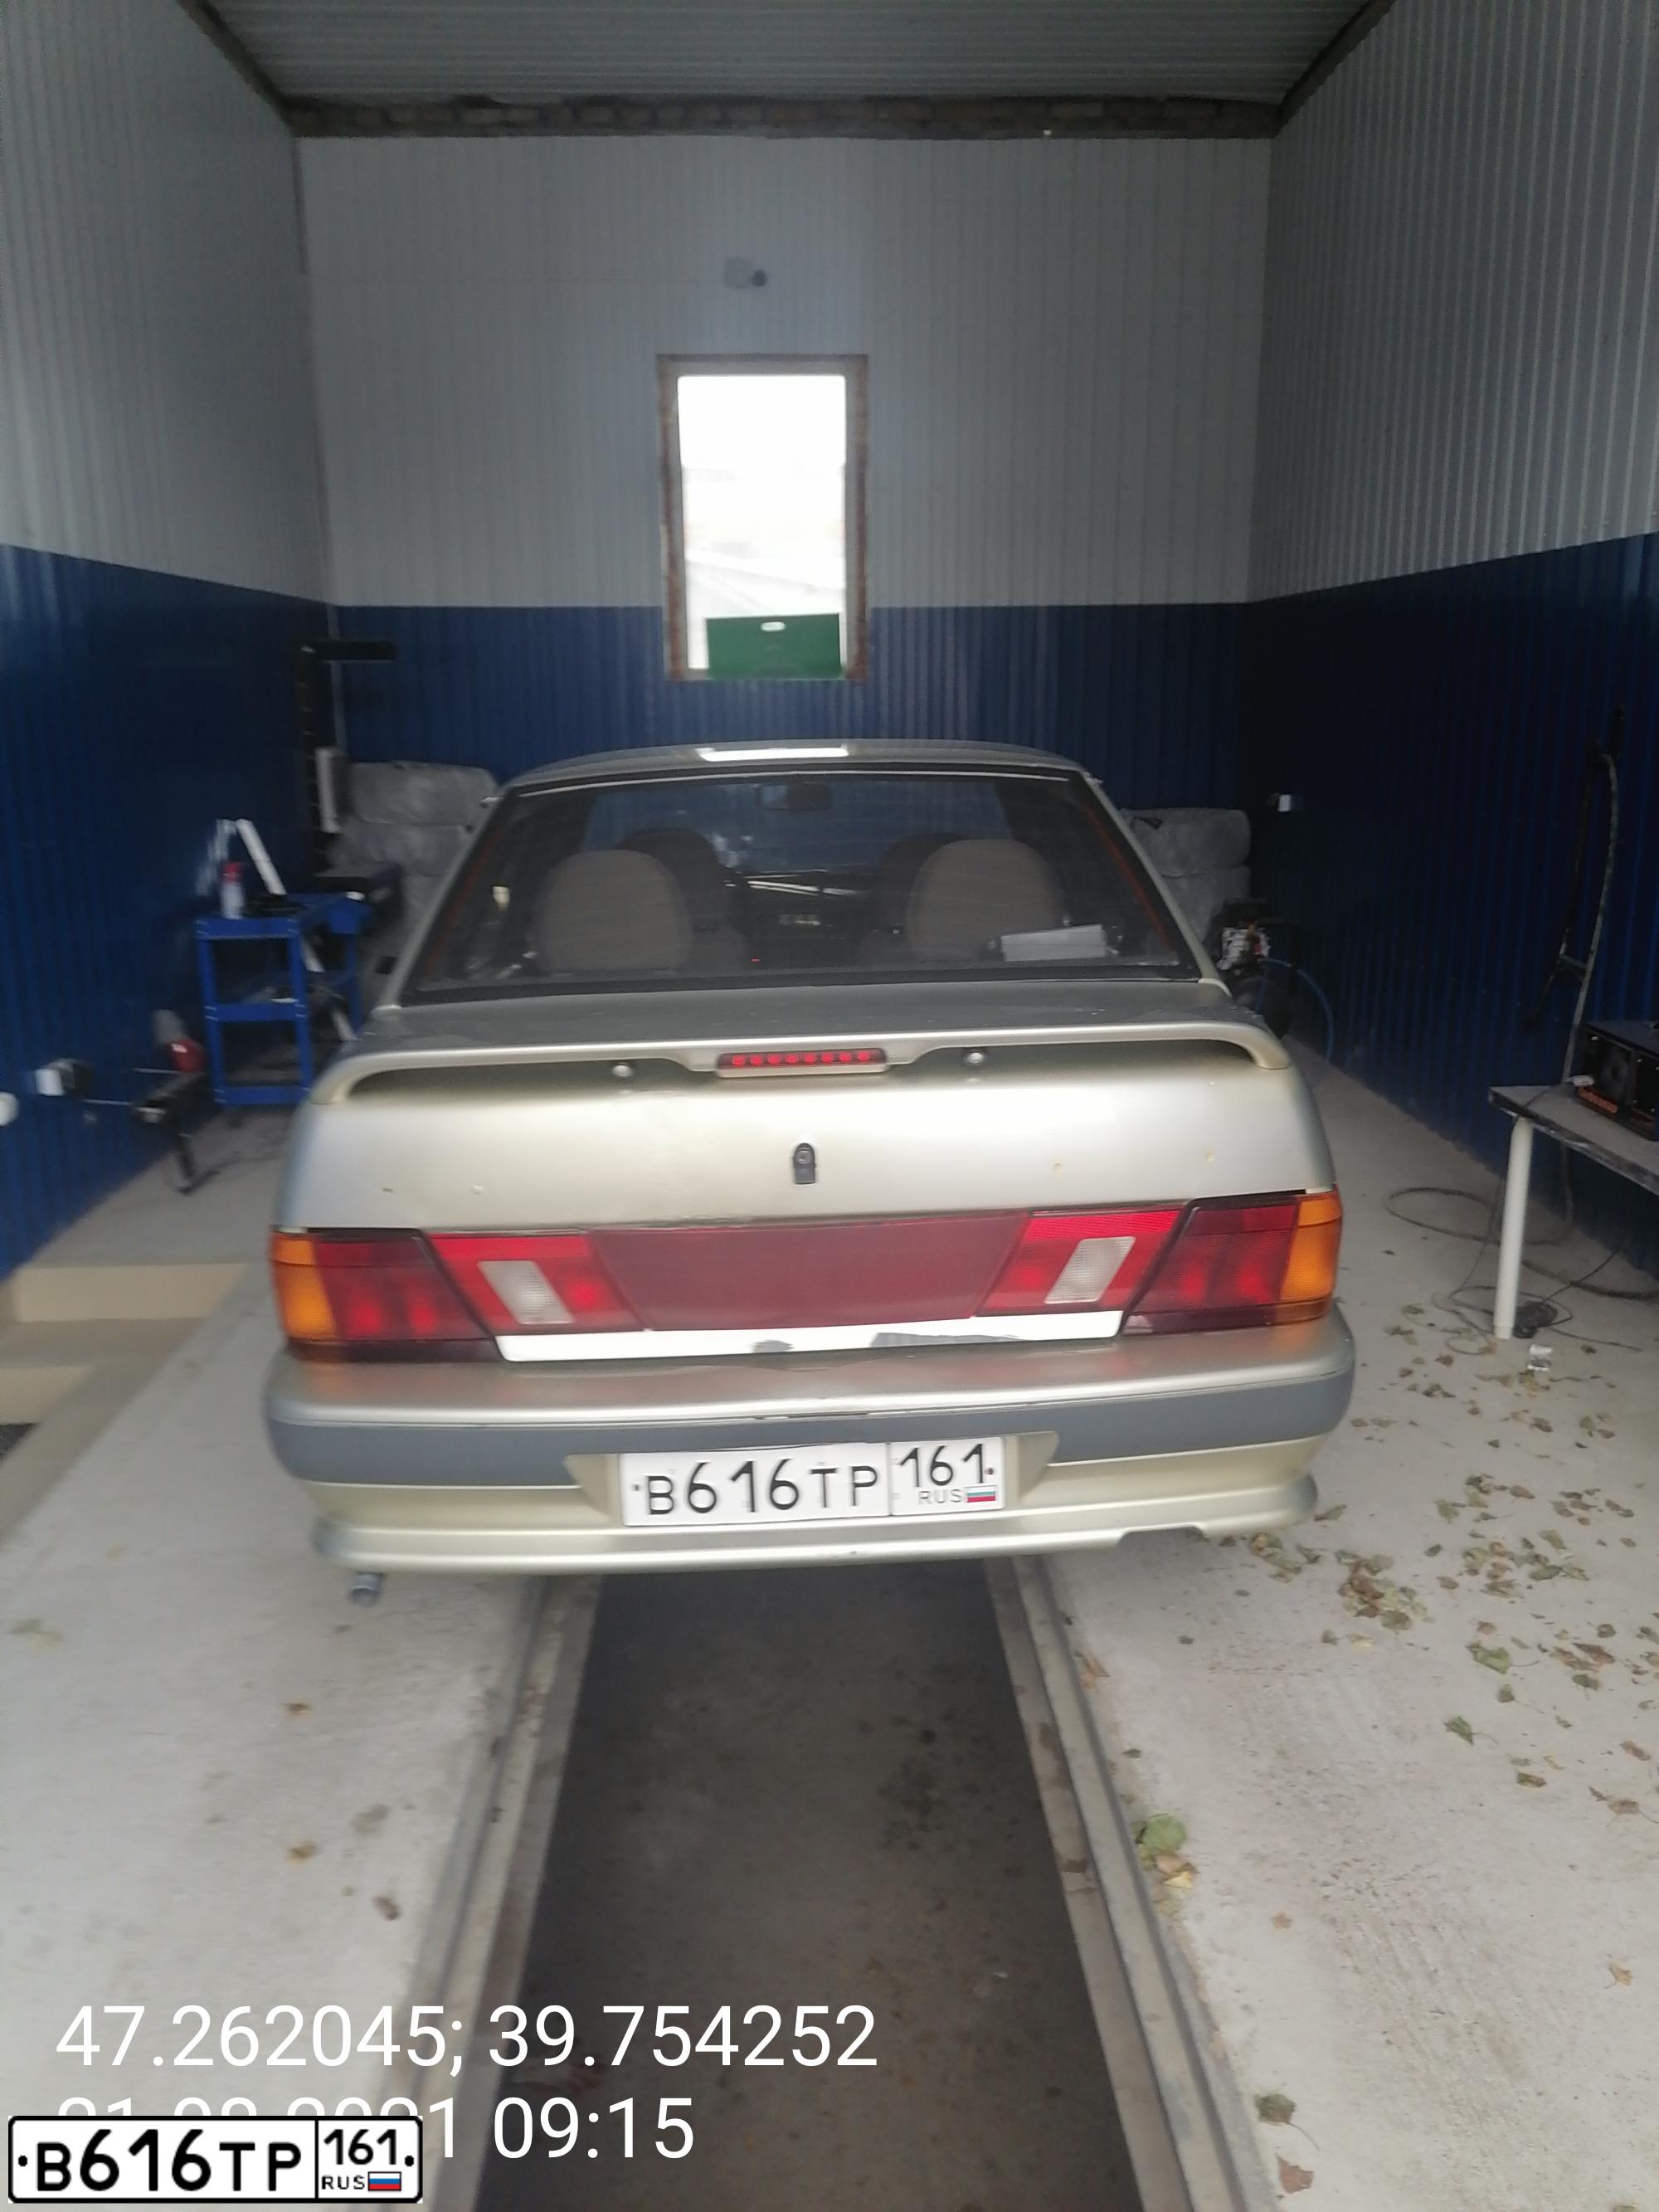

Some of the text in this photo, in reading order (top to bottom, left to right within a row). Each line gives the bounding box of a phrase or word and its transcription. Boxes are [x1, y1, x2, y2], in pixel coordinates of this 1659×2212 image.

[647, 1458, 878, 1515] В616ТР
[897, 1444, 983, 1488] 161
[919, 1489, 961, 1504] RUS
